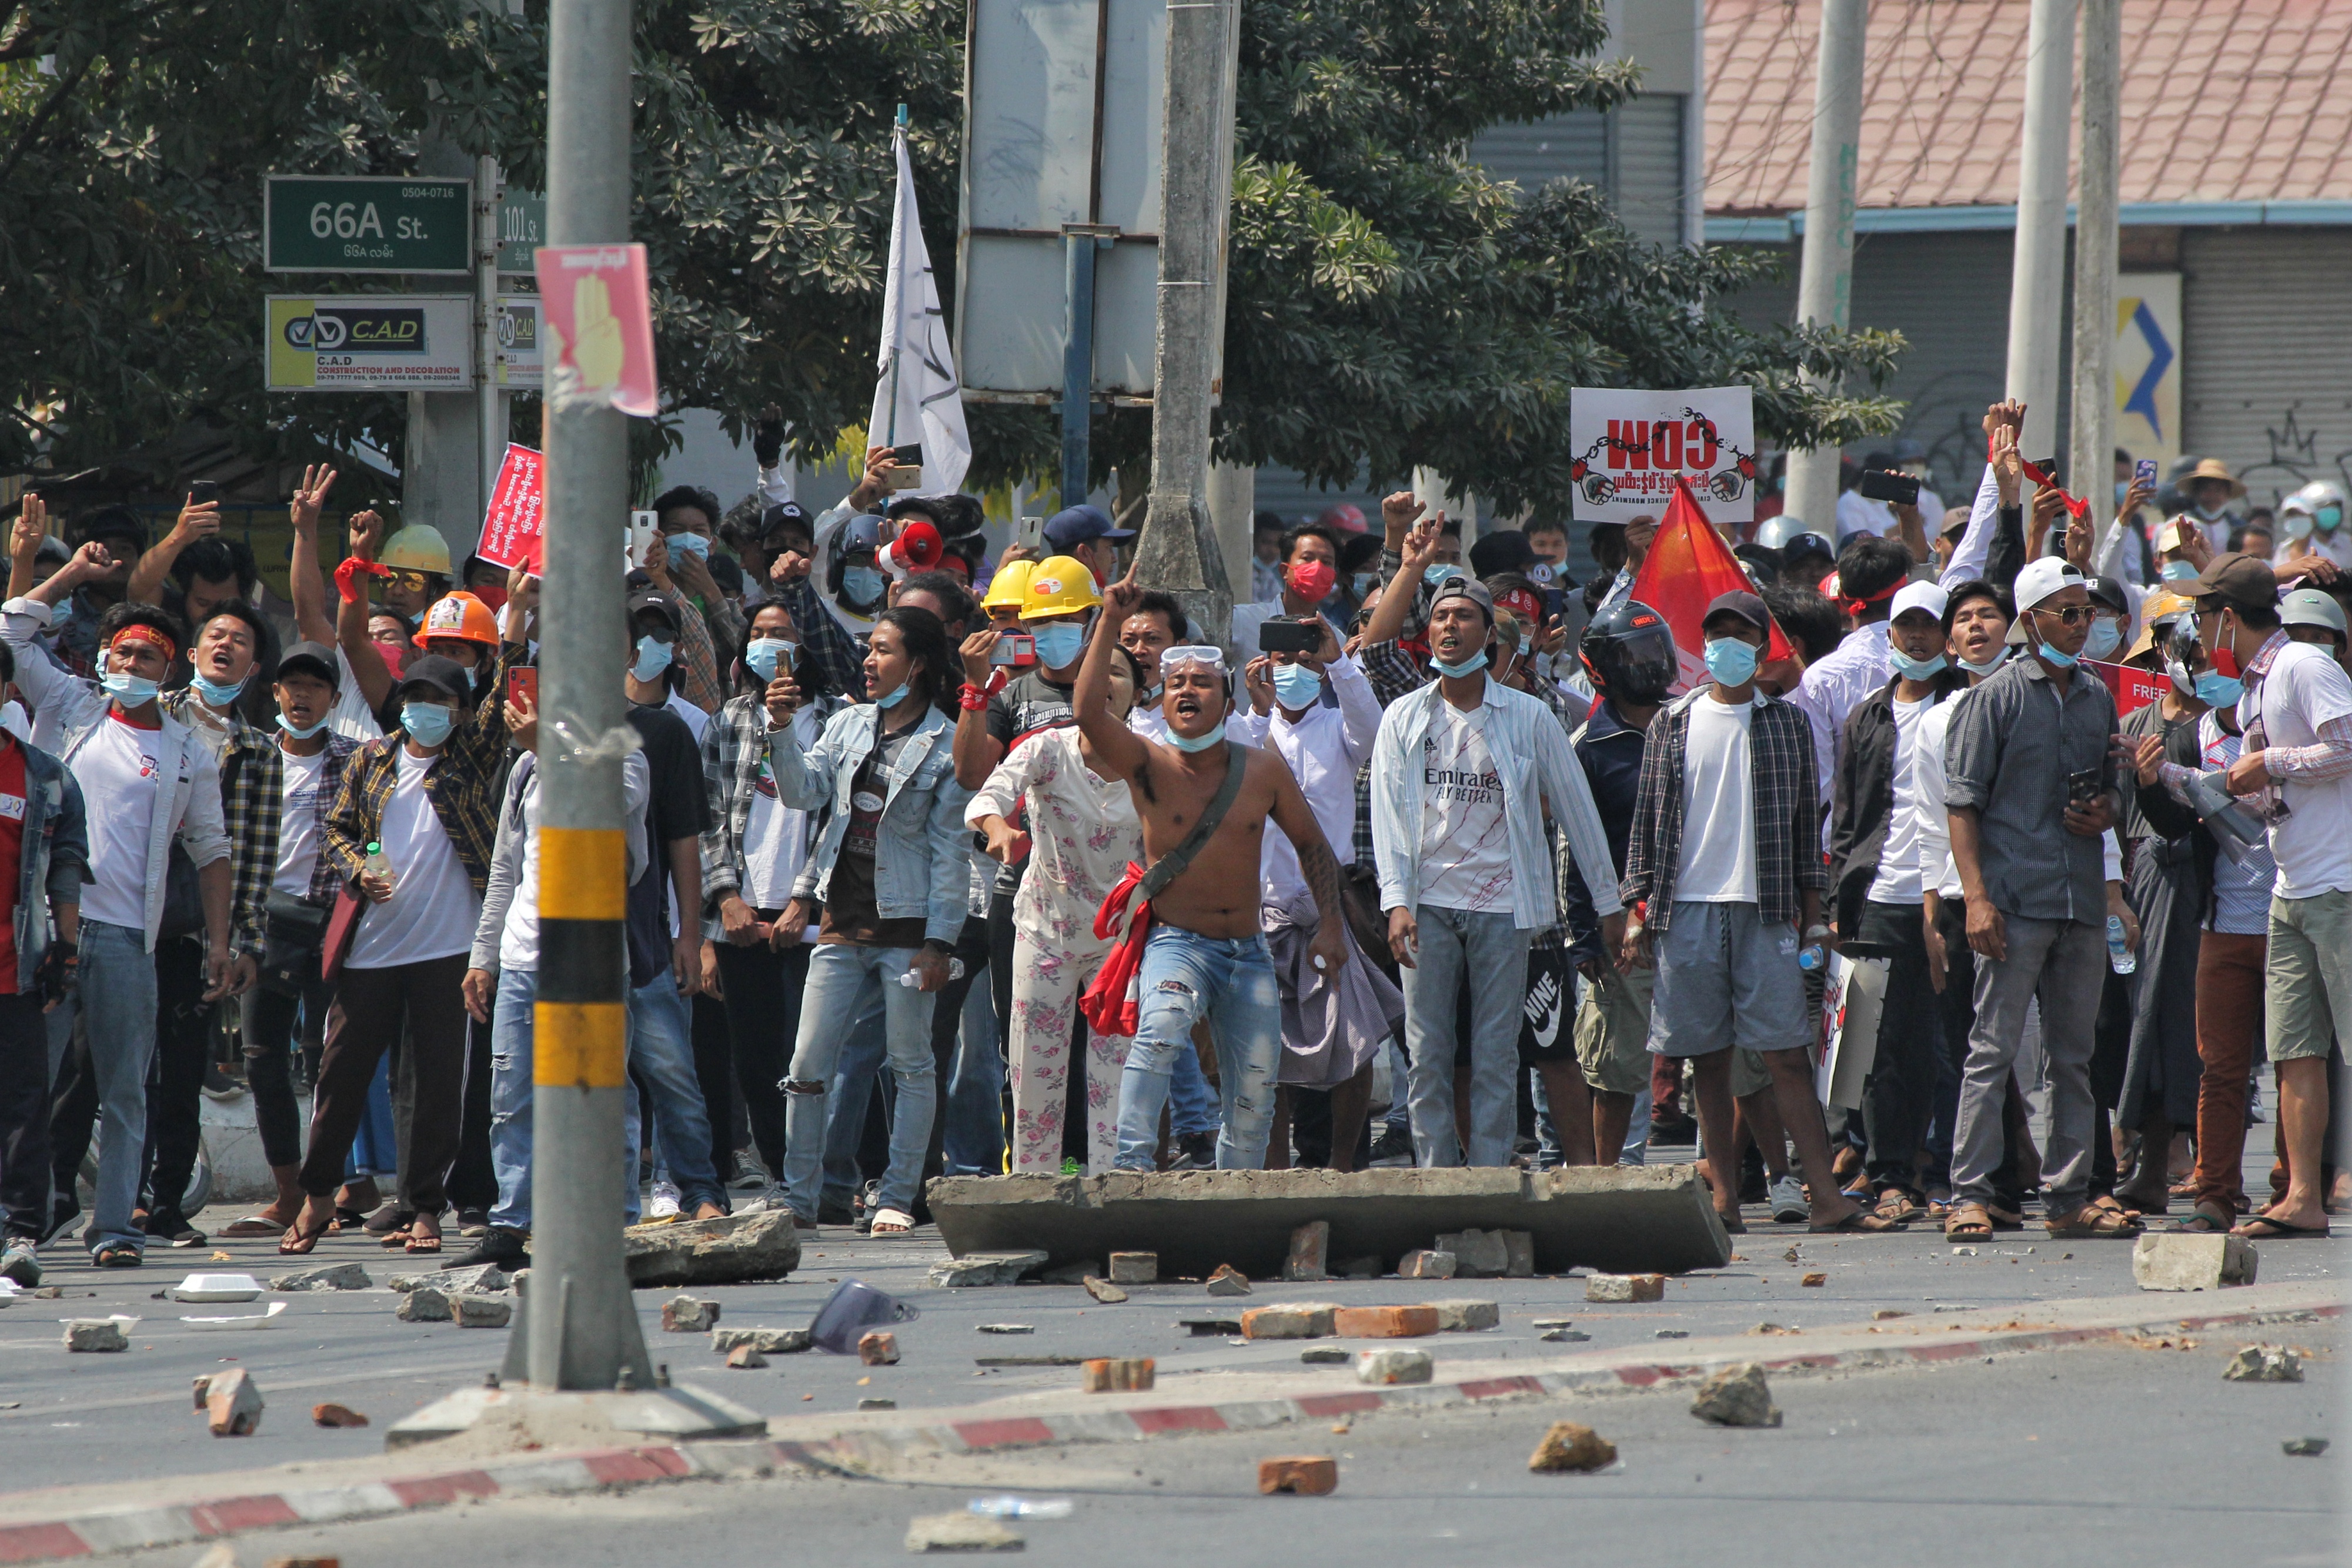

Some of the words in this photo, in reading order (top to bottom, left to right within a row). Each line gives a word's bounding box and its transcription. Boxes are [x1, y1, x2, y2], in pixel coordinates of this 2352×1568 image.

[402, 188, 454, 198] 0504-0716
[310, 202, 384, 238] 66A
[396, 216, 428, 239] St.
[505, 206, 525, 242] 101
[529, 220, 538, 242] St.
[370, 244, 393, 258] လမ်း
[351, 321, 417, 339] C.A.D
[516, 318, 534, 336] C.A.D
[318, 356, 352, 365] C.A.D
[1608, 419, 1717, 470] CDM
[1633, 617, 1656, 626] INDEX
[2133, 683, 2167, 700] FREE
[1425, 768, 1504, 791] Emirates
[1436, 786, 1453, 800] FLY
[1455, 788, 1492, 804] BETTER
[1524, 971, 1557, 1025] NINE
